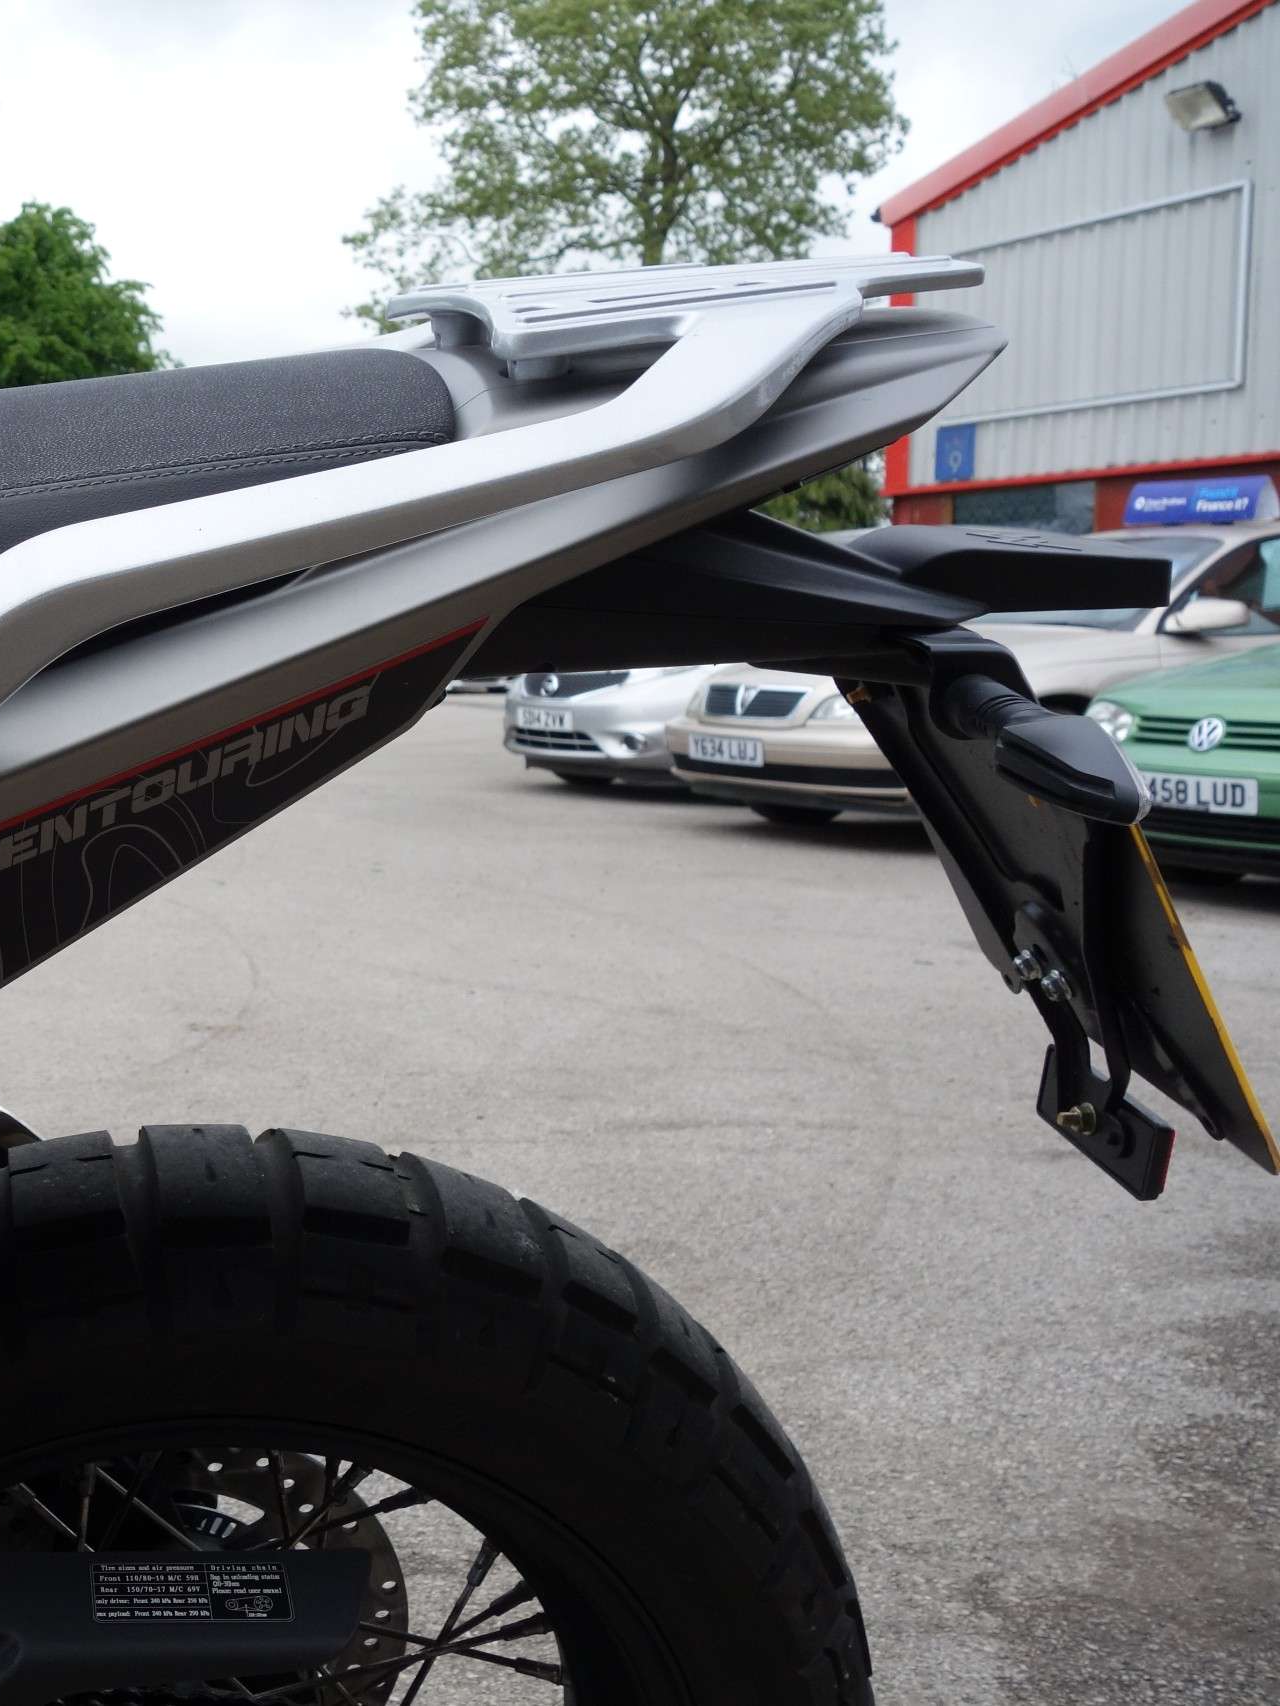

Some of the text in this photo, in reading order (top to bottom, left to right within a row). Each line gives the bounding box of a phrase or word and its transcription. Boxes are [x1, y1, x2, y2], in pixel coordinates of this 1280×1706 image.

[693, 737, 724, 755] Y634
[1149, 777, 1246, 808] 458 LUD
